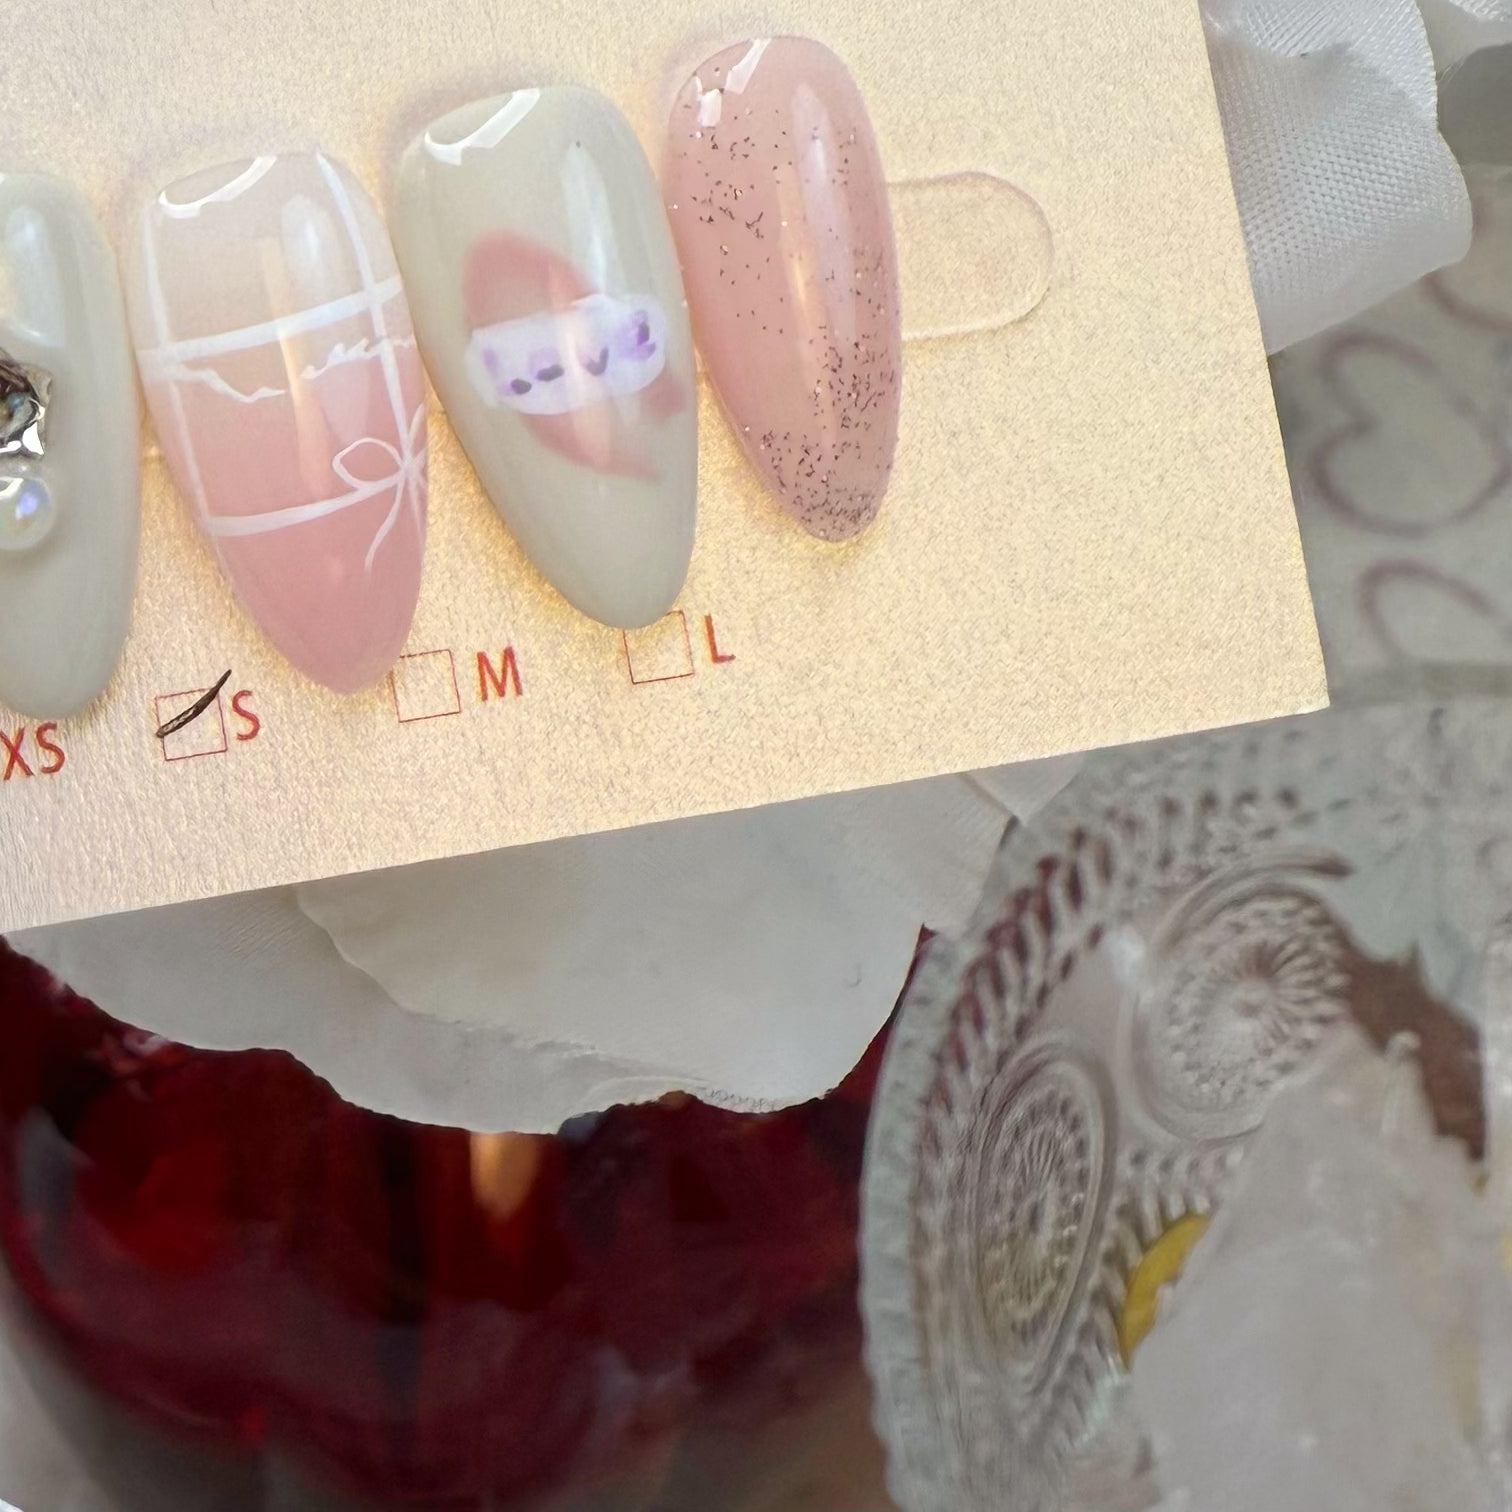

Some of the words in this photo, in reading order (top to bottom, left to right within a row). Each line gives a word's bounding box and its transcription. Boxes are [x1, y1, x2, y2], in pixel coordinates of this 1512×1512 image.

[230, 689, 261, 742] S
[475, 646, 525, 703] M
[704, 614, 737, 664] L
